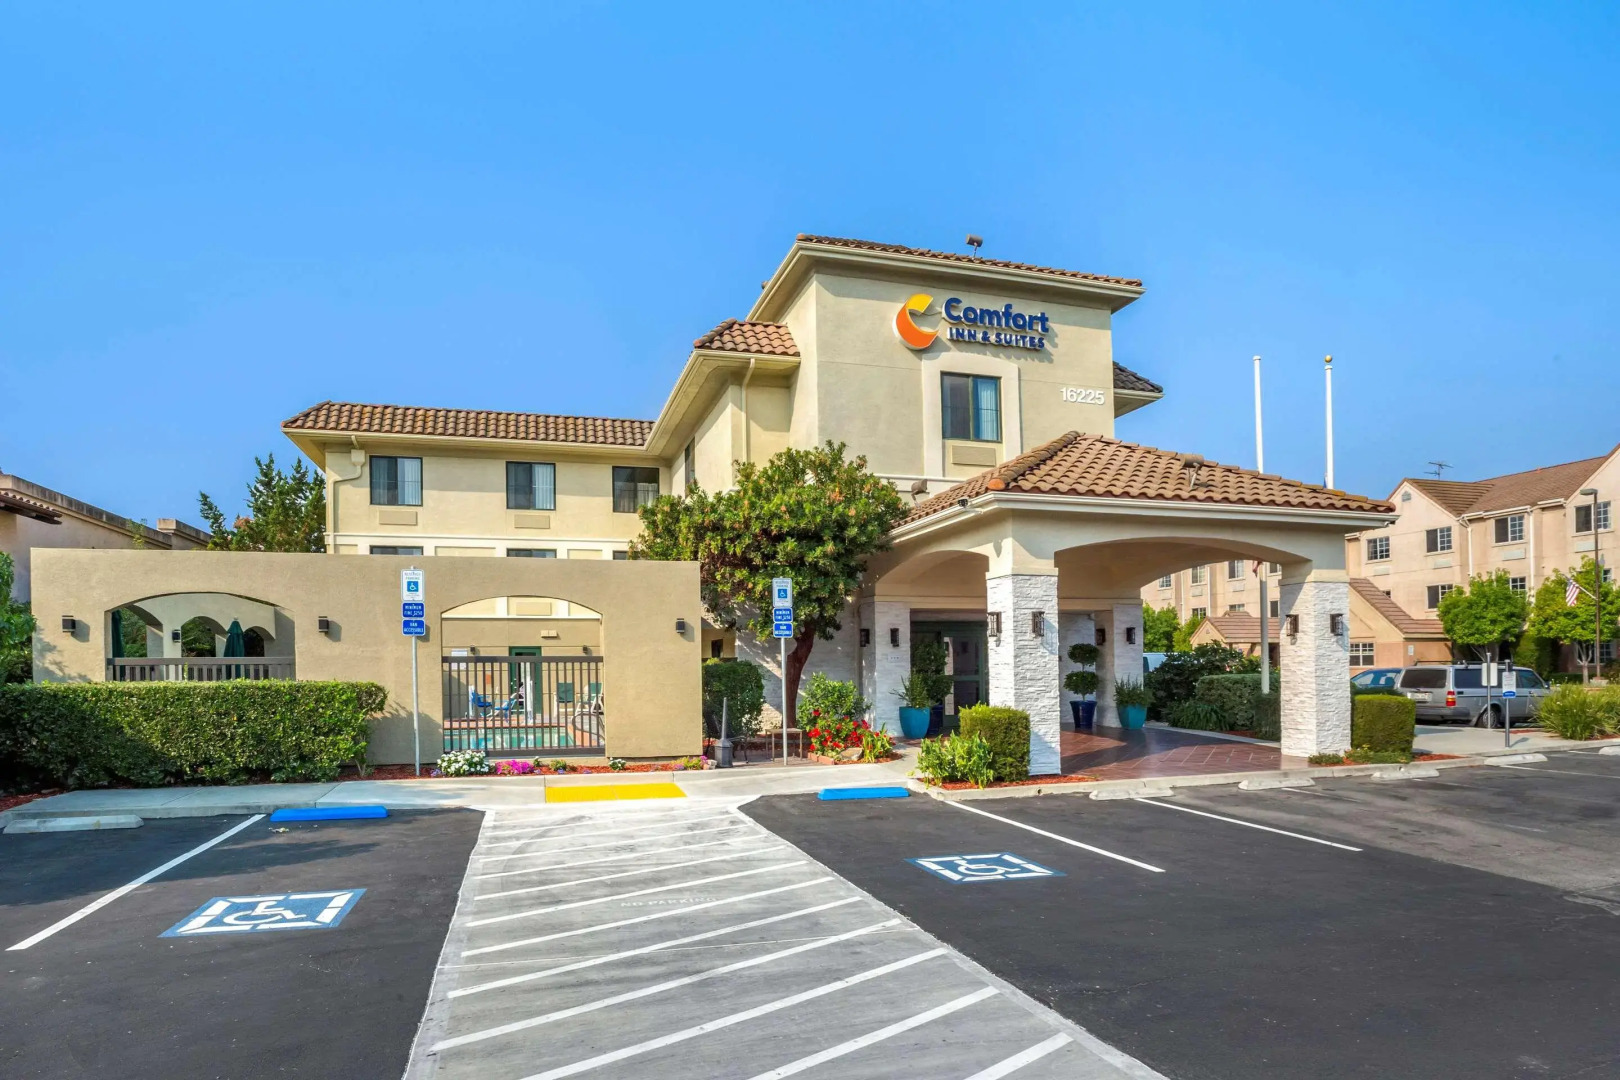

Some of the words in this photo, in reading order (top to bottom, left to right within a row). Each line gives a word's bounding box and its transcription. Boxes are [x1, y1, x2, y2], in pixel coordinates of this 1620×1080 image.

[942, 297, 1050, 334] Comfort
[947, 327, 977, 342] INN
[981, 330, 991, 343] &
[994, 331, 1045, 351] SUITES
[1060, 387, 1105, 405] 16225
